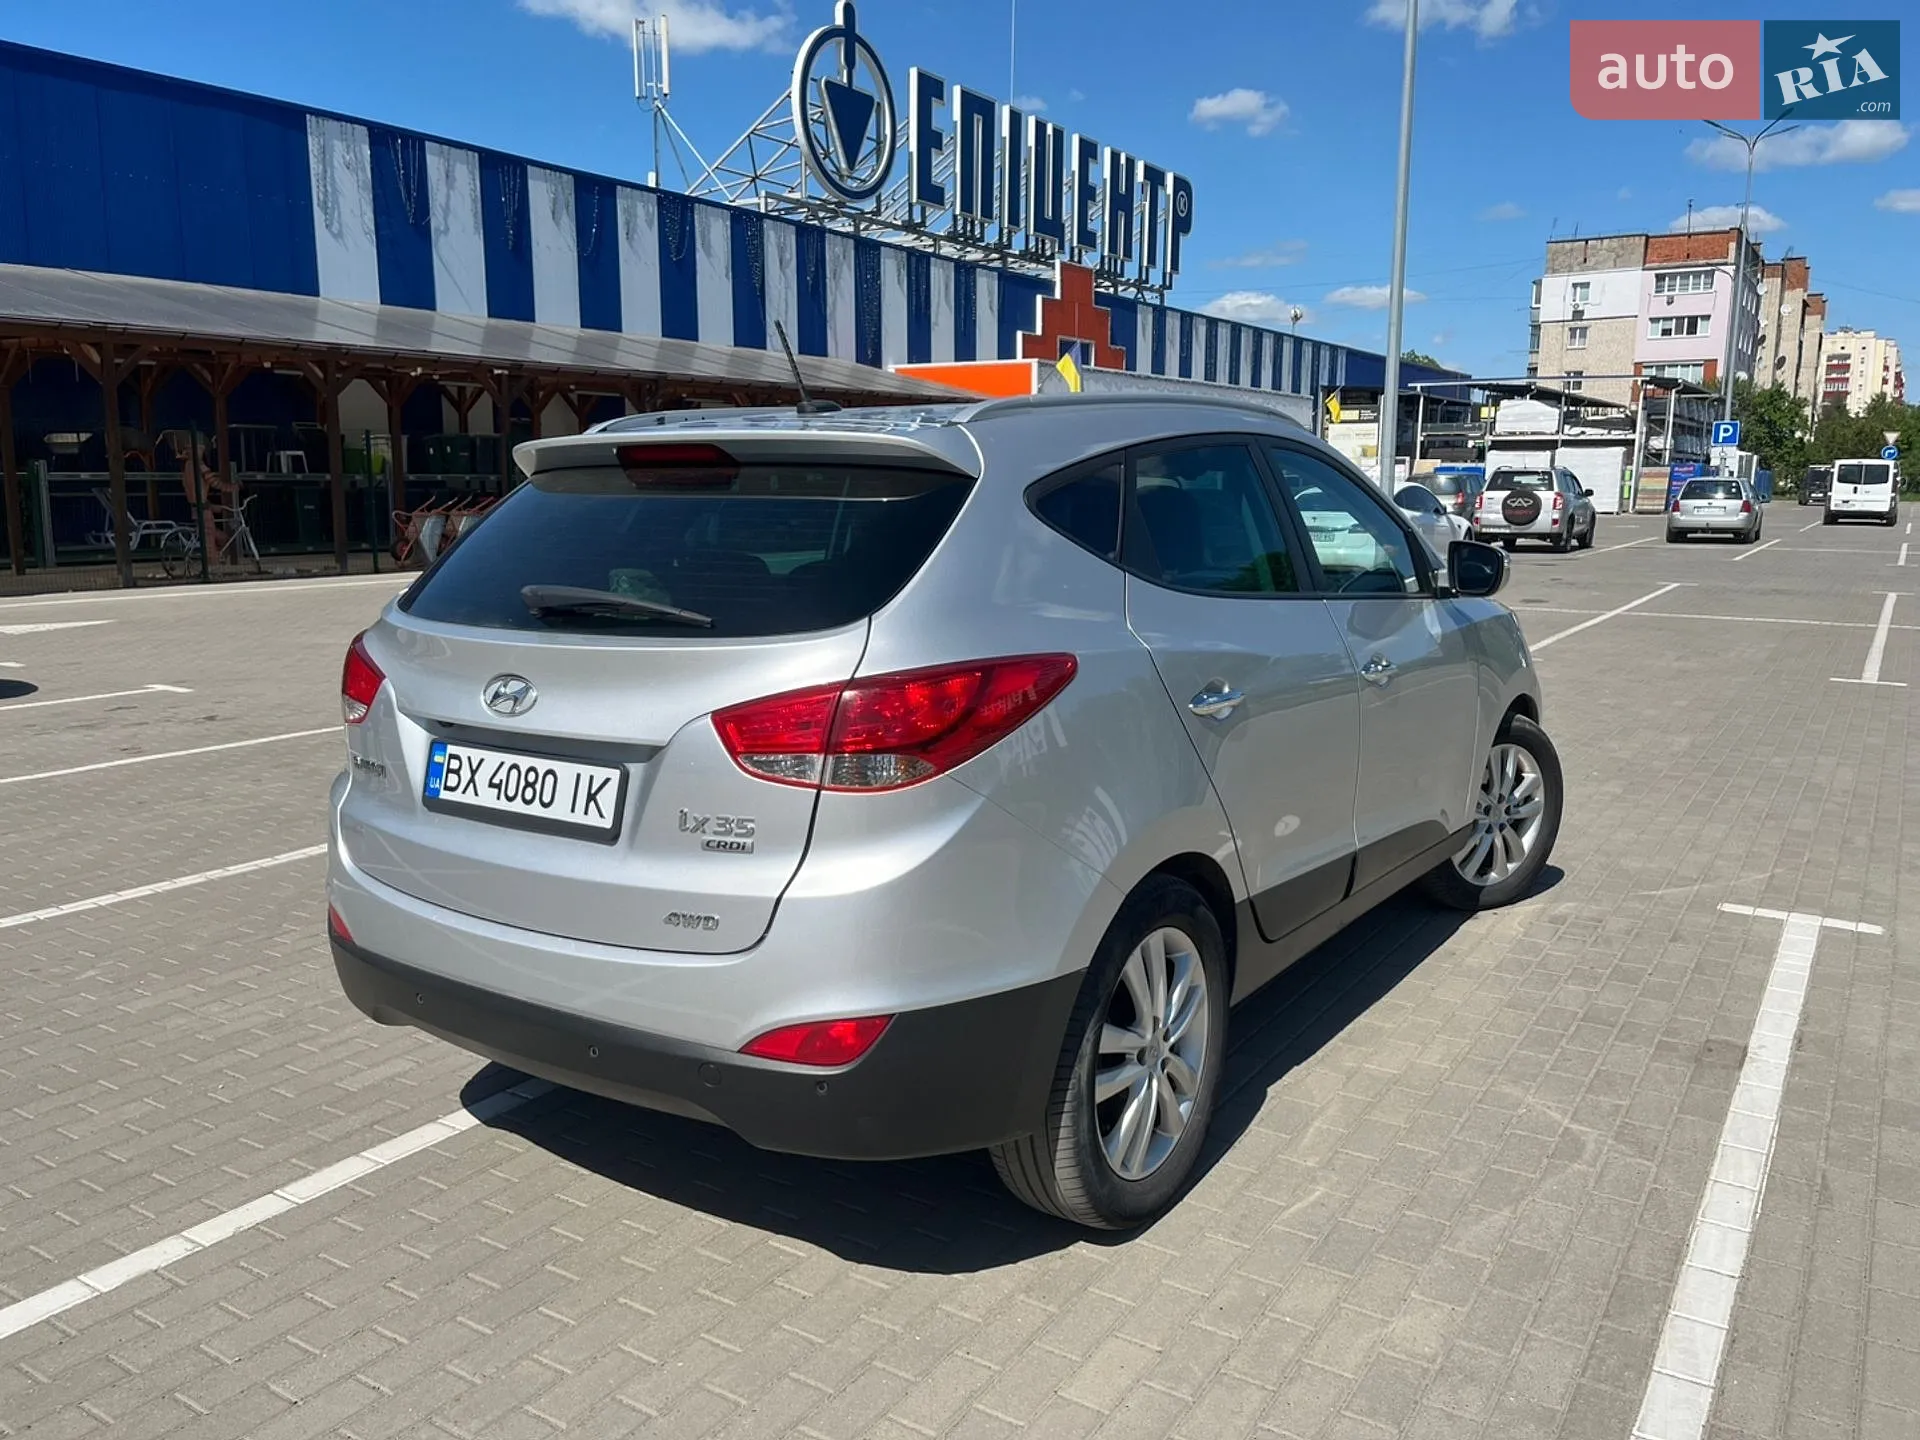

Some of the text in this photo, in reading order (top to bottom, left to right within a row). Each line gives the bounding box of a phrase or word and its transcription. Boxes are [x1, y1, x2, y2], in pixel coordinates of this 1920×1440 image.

[908, 66, 1194, 275] ЕПІЦЕНТР
[1718, 424, 1733, 443] P
[443, 753, 486, 797] BX
[488, 761, 558, 809] 4080
[570, 772, 613, 819] IK
[663, 911, 720, 931] 4WD
